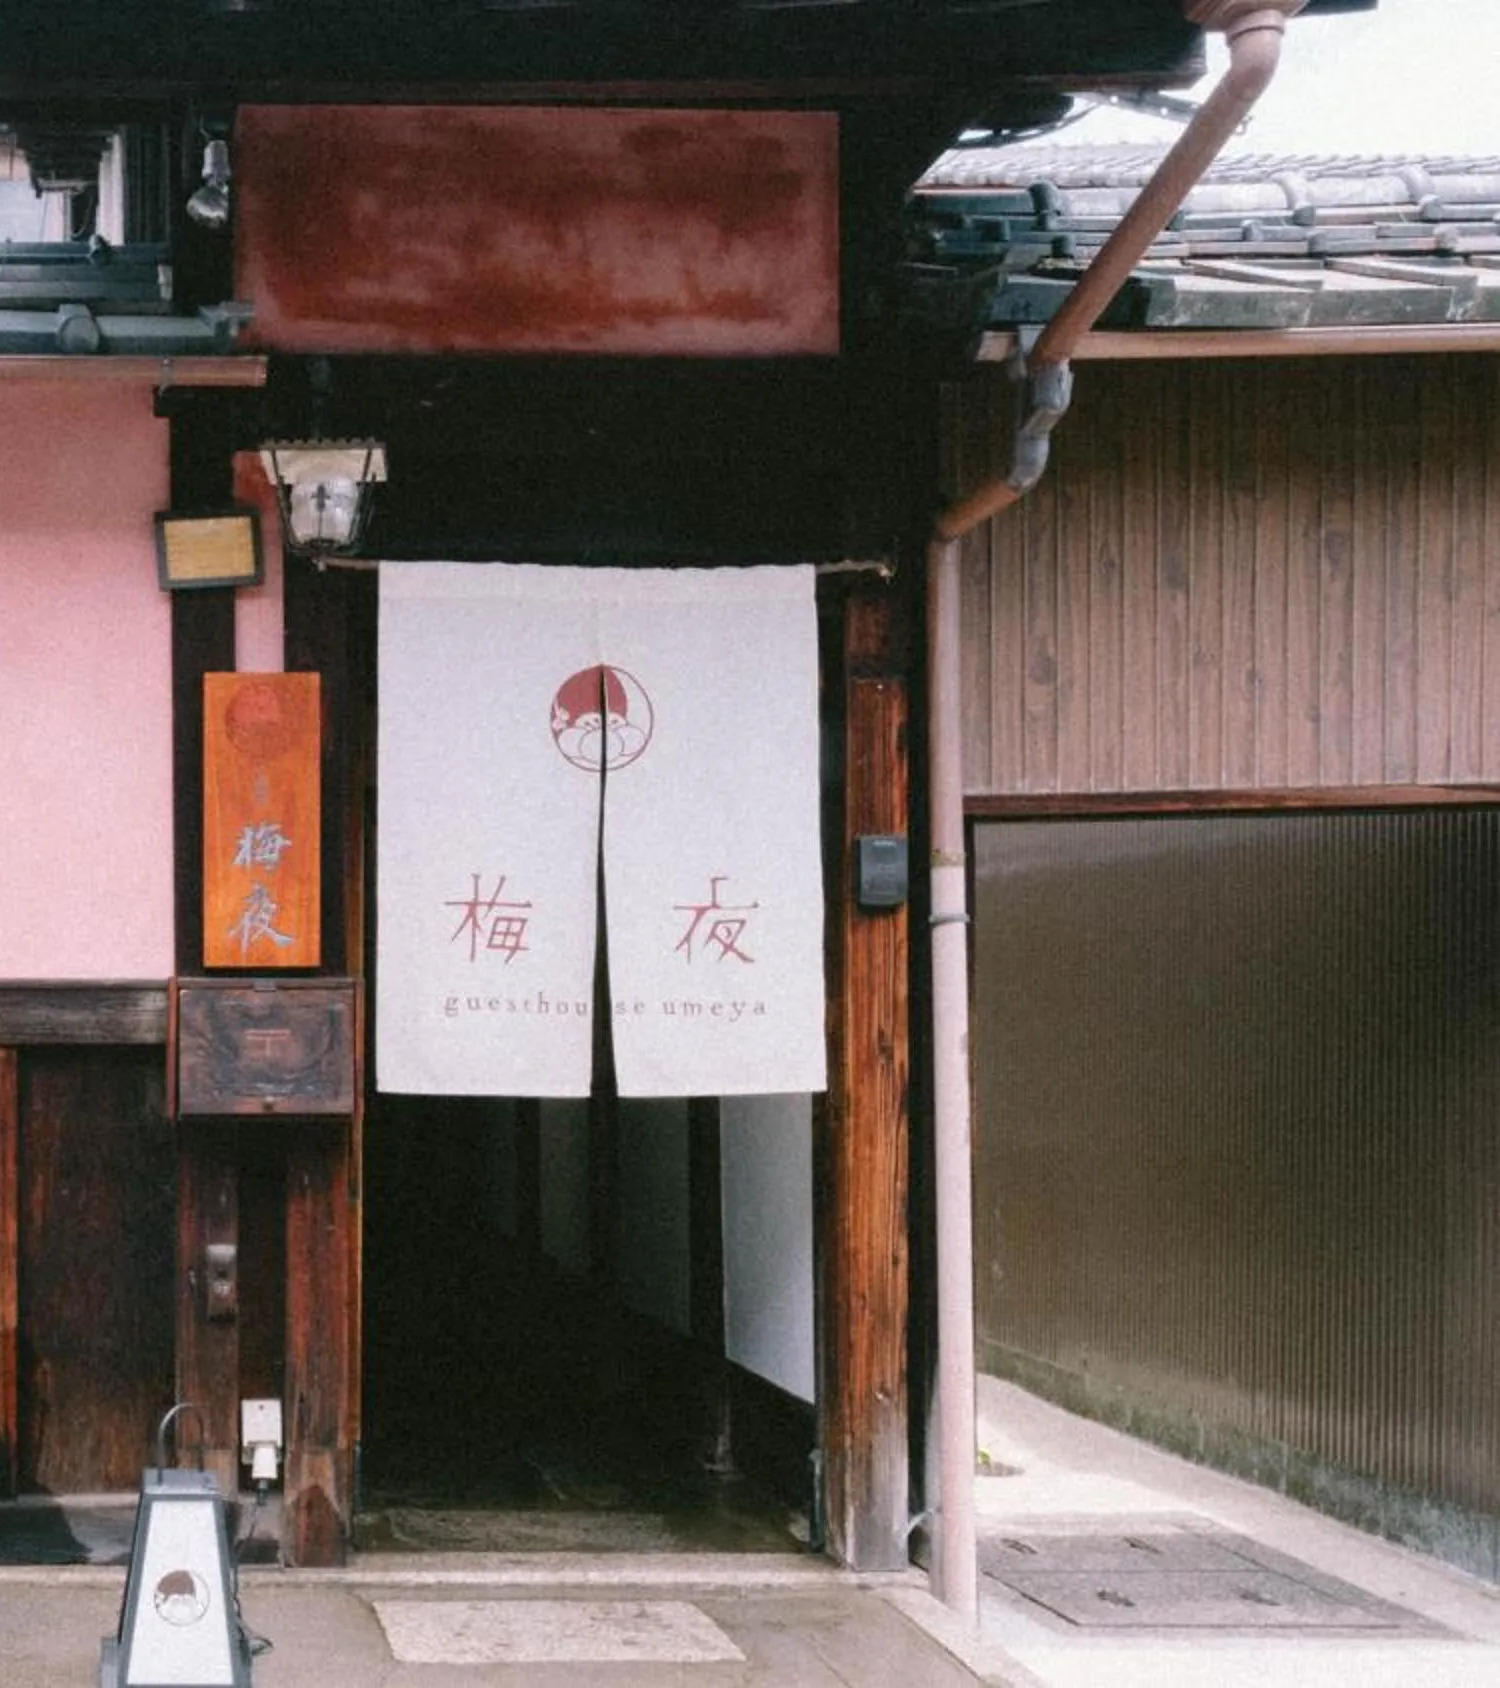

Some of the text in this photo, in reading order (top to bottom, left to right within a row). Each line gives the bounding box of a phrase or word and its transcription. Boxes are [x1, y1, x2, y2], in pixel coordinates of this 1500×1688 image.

[228, 822, 293, 953] 梅夜
[445, 873, 760, 965] 梅夜
[444, 991, 766, 1022] guesthouse umeya
